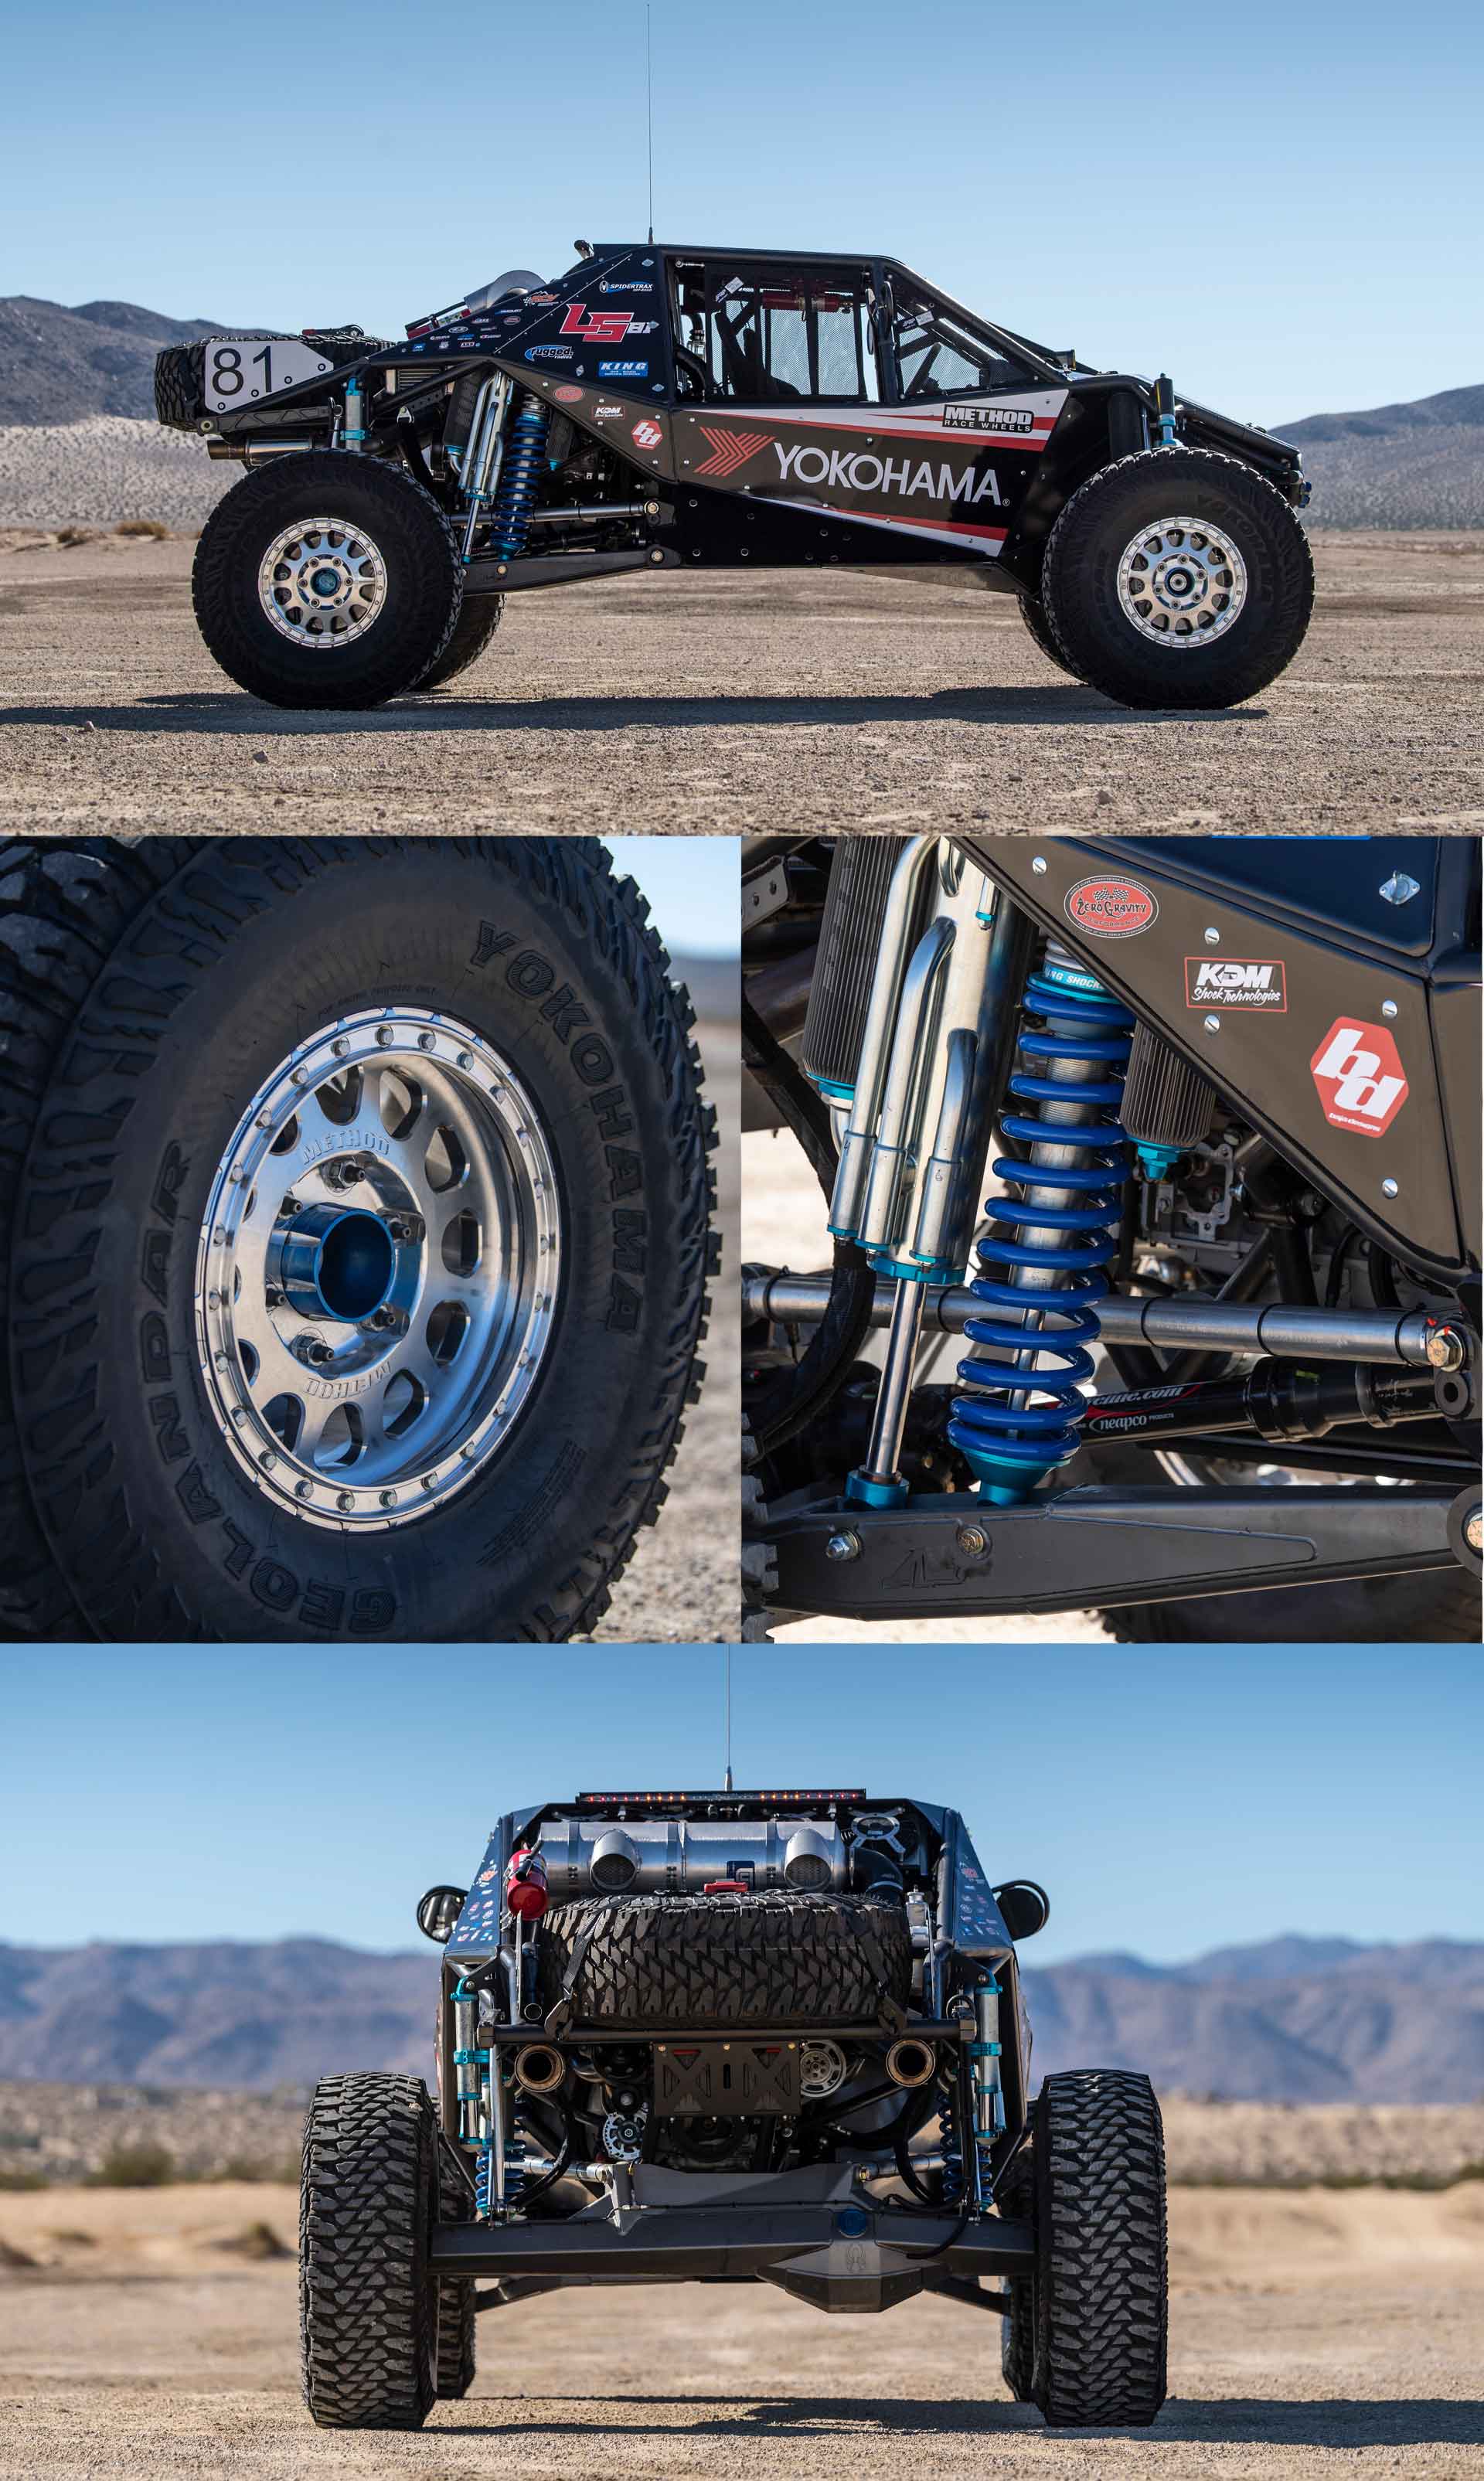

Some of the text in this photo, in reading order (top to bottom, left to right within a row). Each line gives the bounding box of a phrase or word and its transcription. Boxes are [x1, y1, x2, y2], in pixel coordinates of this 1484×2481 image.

[212, 345, 273, 396] 81
[945, 406, 1033, 425] METHOD
[945, 420, 1031, 432] RACE WHEELS
[773, 442, 1002, 506] YOKOHAMA
[1196, 963, 1274, 989] KDM
[1191, 987, 1281, 1006] Shock Technologies
[470, 920, 648, 1335] YOKOHAMA
[304, 1129, 390, 1165] METHOD
[140, 1138, 397, 1635] GEOLANDAR
[302, 1361, 392, 1399] METHOD
[1100, 1414, 1147, 1430] neapco
